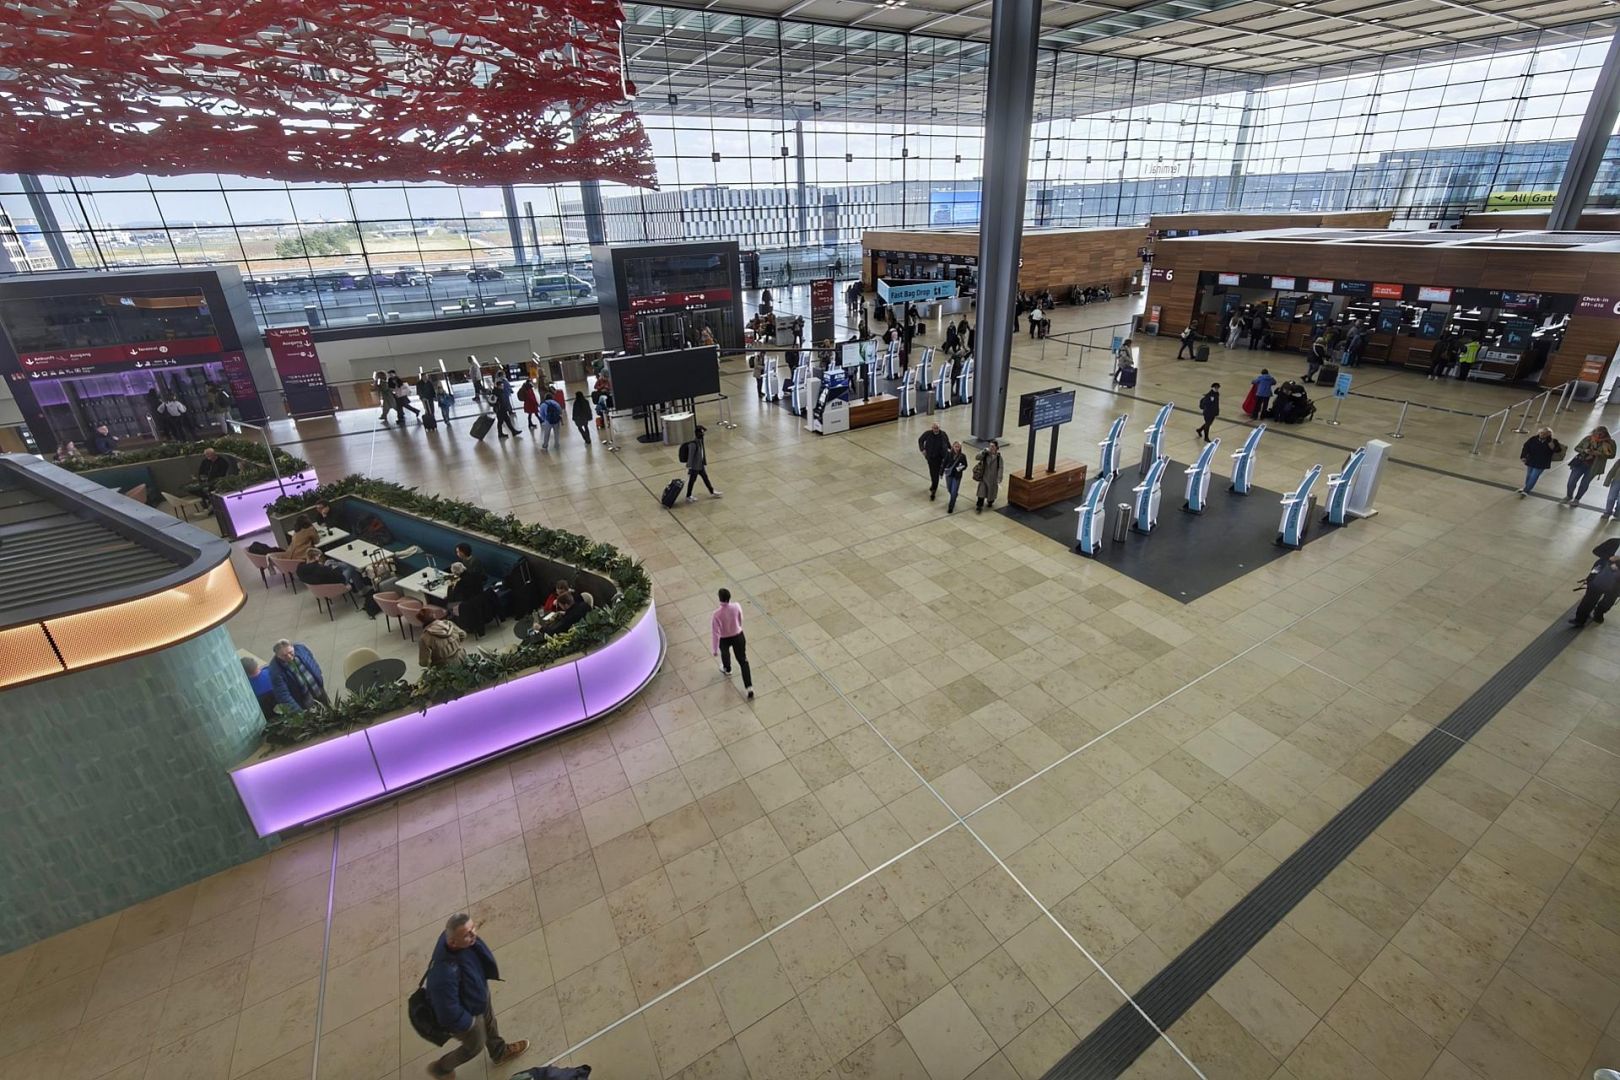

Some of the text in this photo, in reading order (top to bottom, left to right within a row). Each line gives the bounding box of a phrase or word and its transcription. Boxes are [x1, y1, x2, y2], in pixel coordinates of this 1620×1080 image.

[1510, 194, 1526, 203] All
[1166, 270, 1173, 280] 6
[891, 288, 931, 299] Fast Bag Drop
